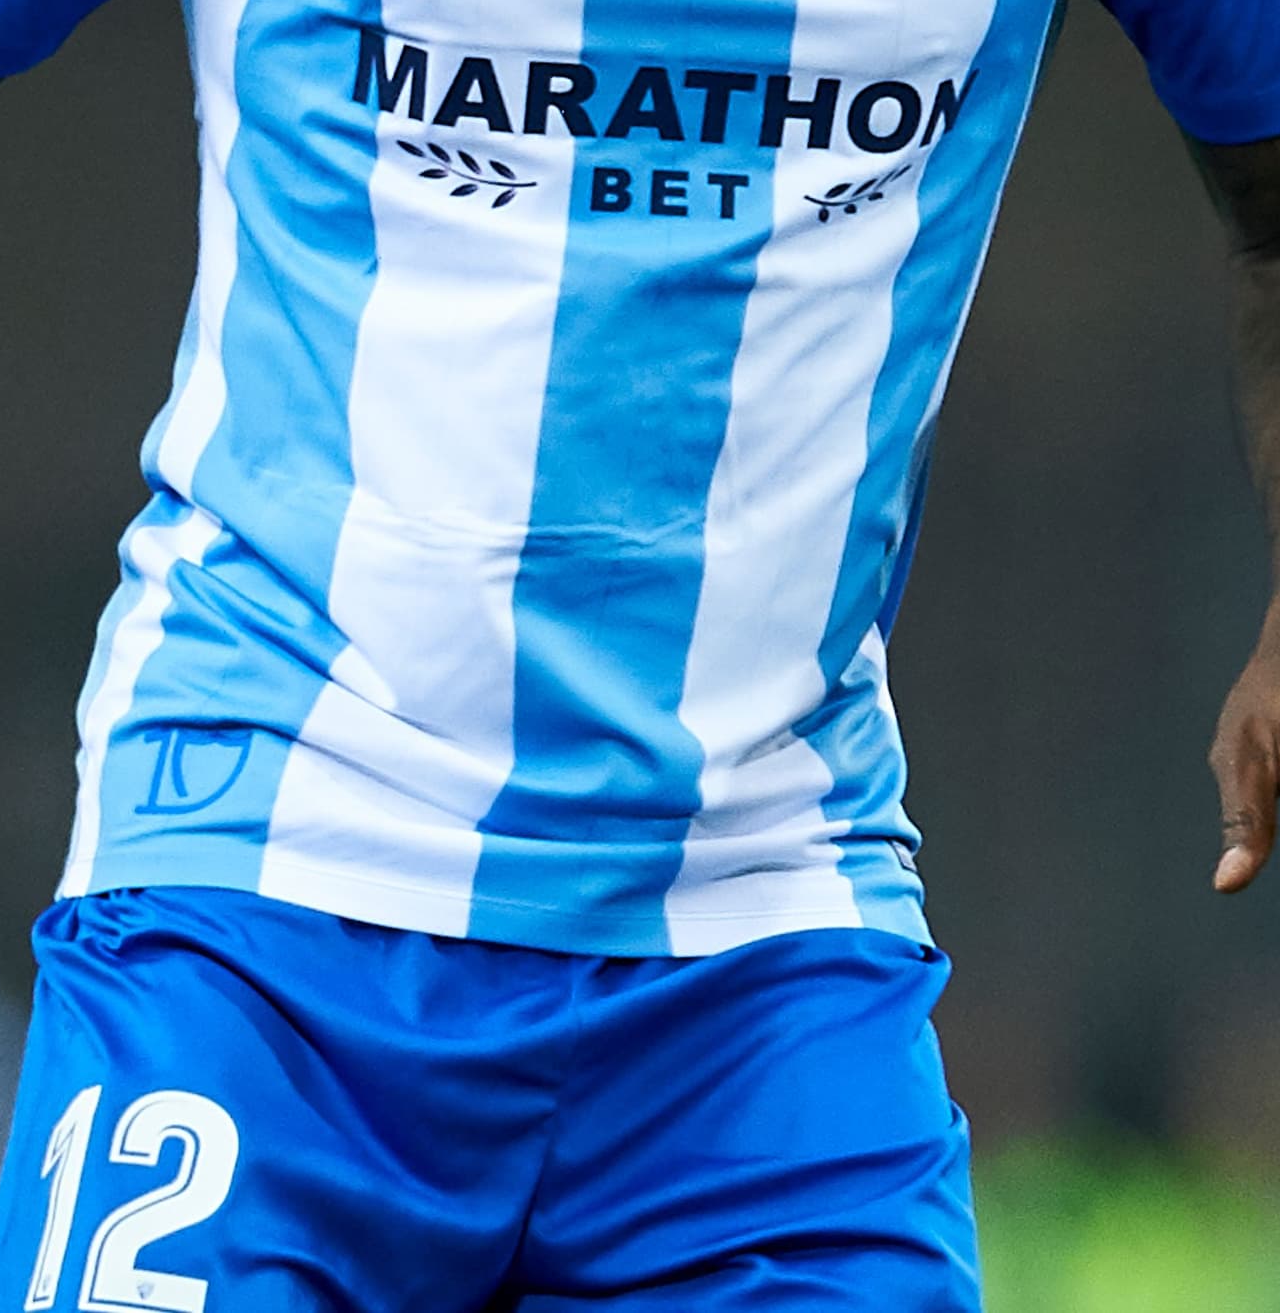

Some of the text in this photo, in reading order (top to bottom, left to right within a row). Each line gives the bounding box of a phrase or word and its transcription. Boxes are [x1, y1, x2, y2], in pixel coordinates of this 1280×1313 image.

[351, 27, 979, 154] MARATHON
[589, 166, 750, 220] BET
[23, 1084, 239, 1313] 12
